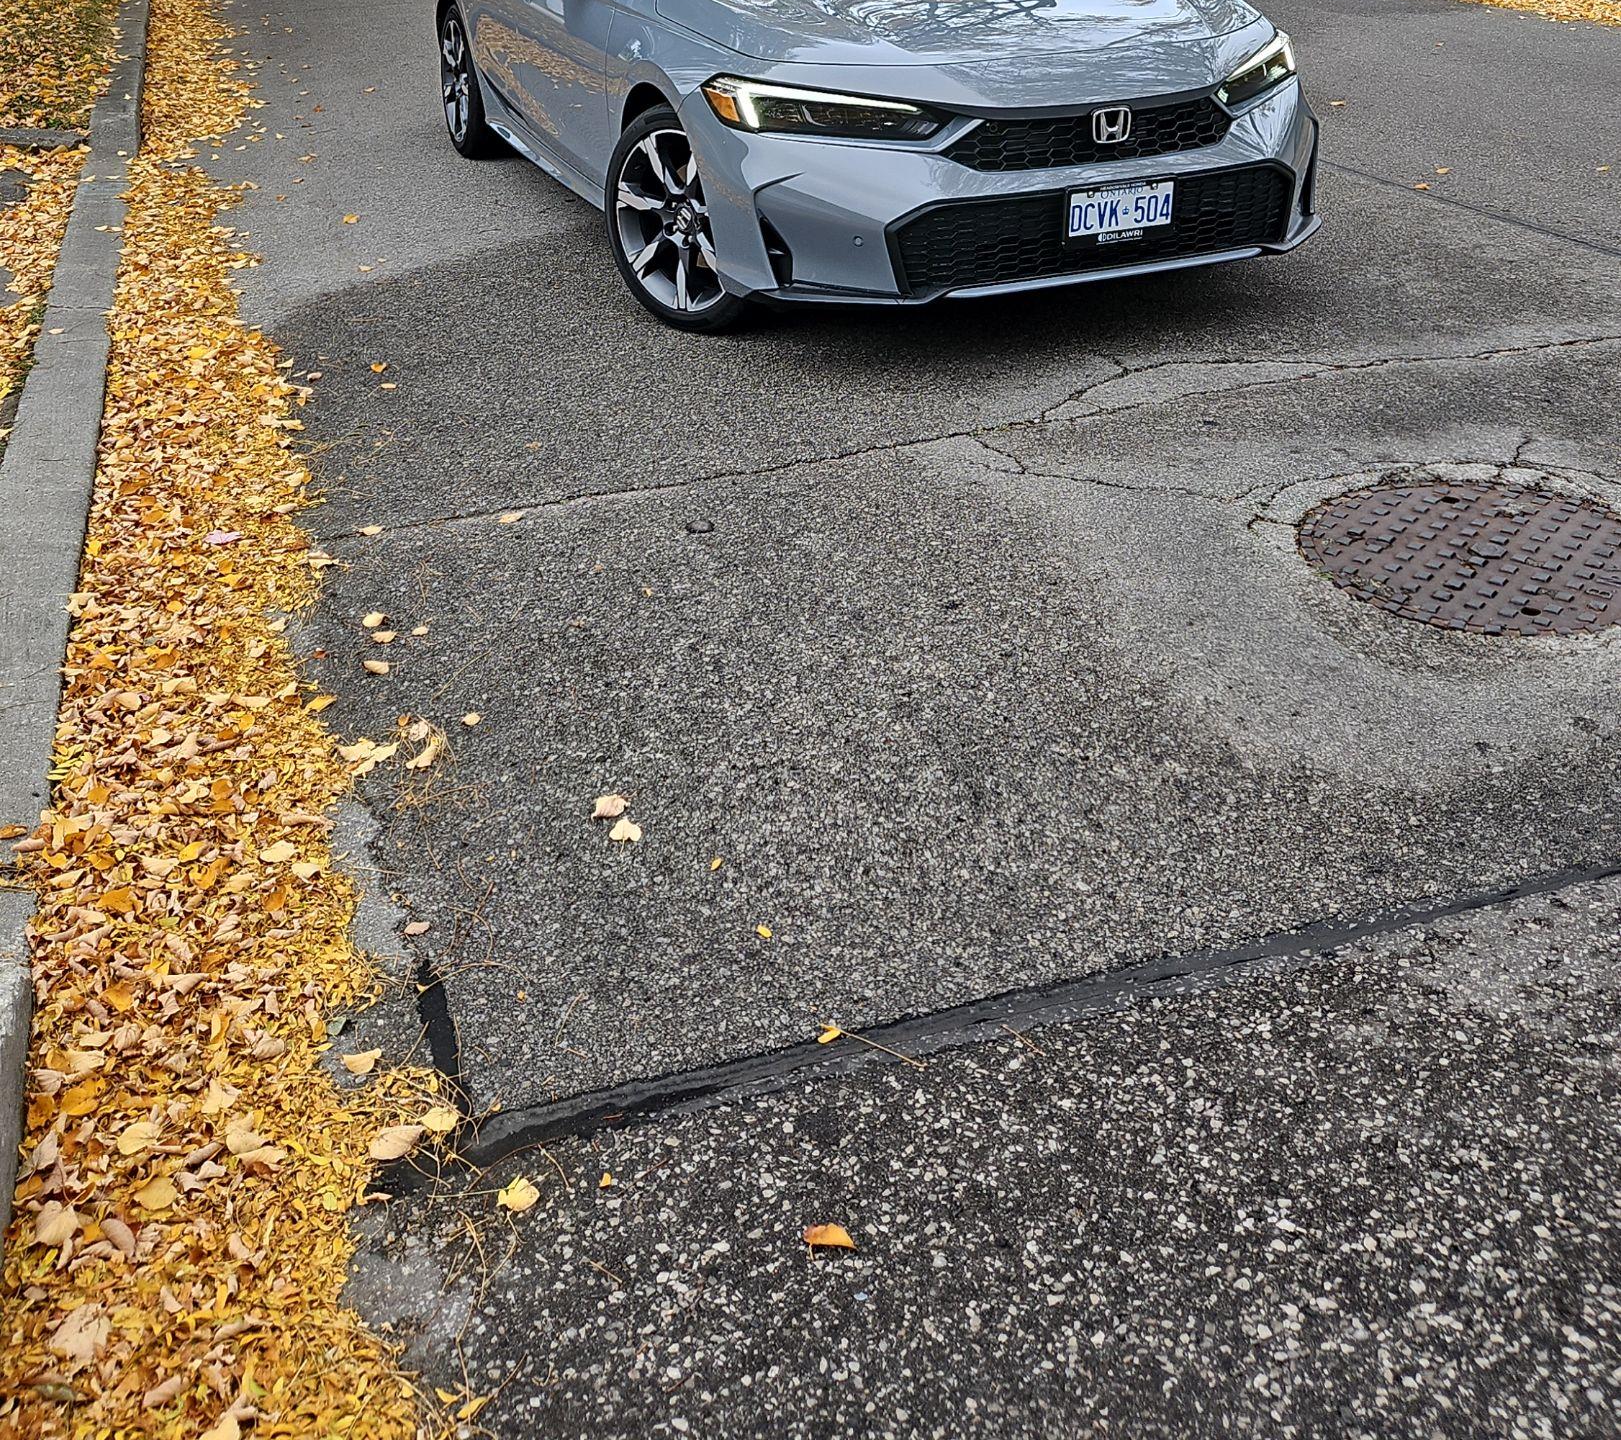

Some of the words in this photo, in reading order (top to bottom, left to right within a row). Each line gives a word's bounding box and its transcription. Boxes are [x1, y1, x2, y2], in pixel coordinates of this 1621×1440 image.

[1101, 186, 1144, 199] ONTARIO
[1070, 199, 1121, 233] DCVK
[1133, 193, 1171, 224] 504
